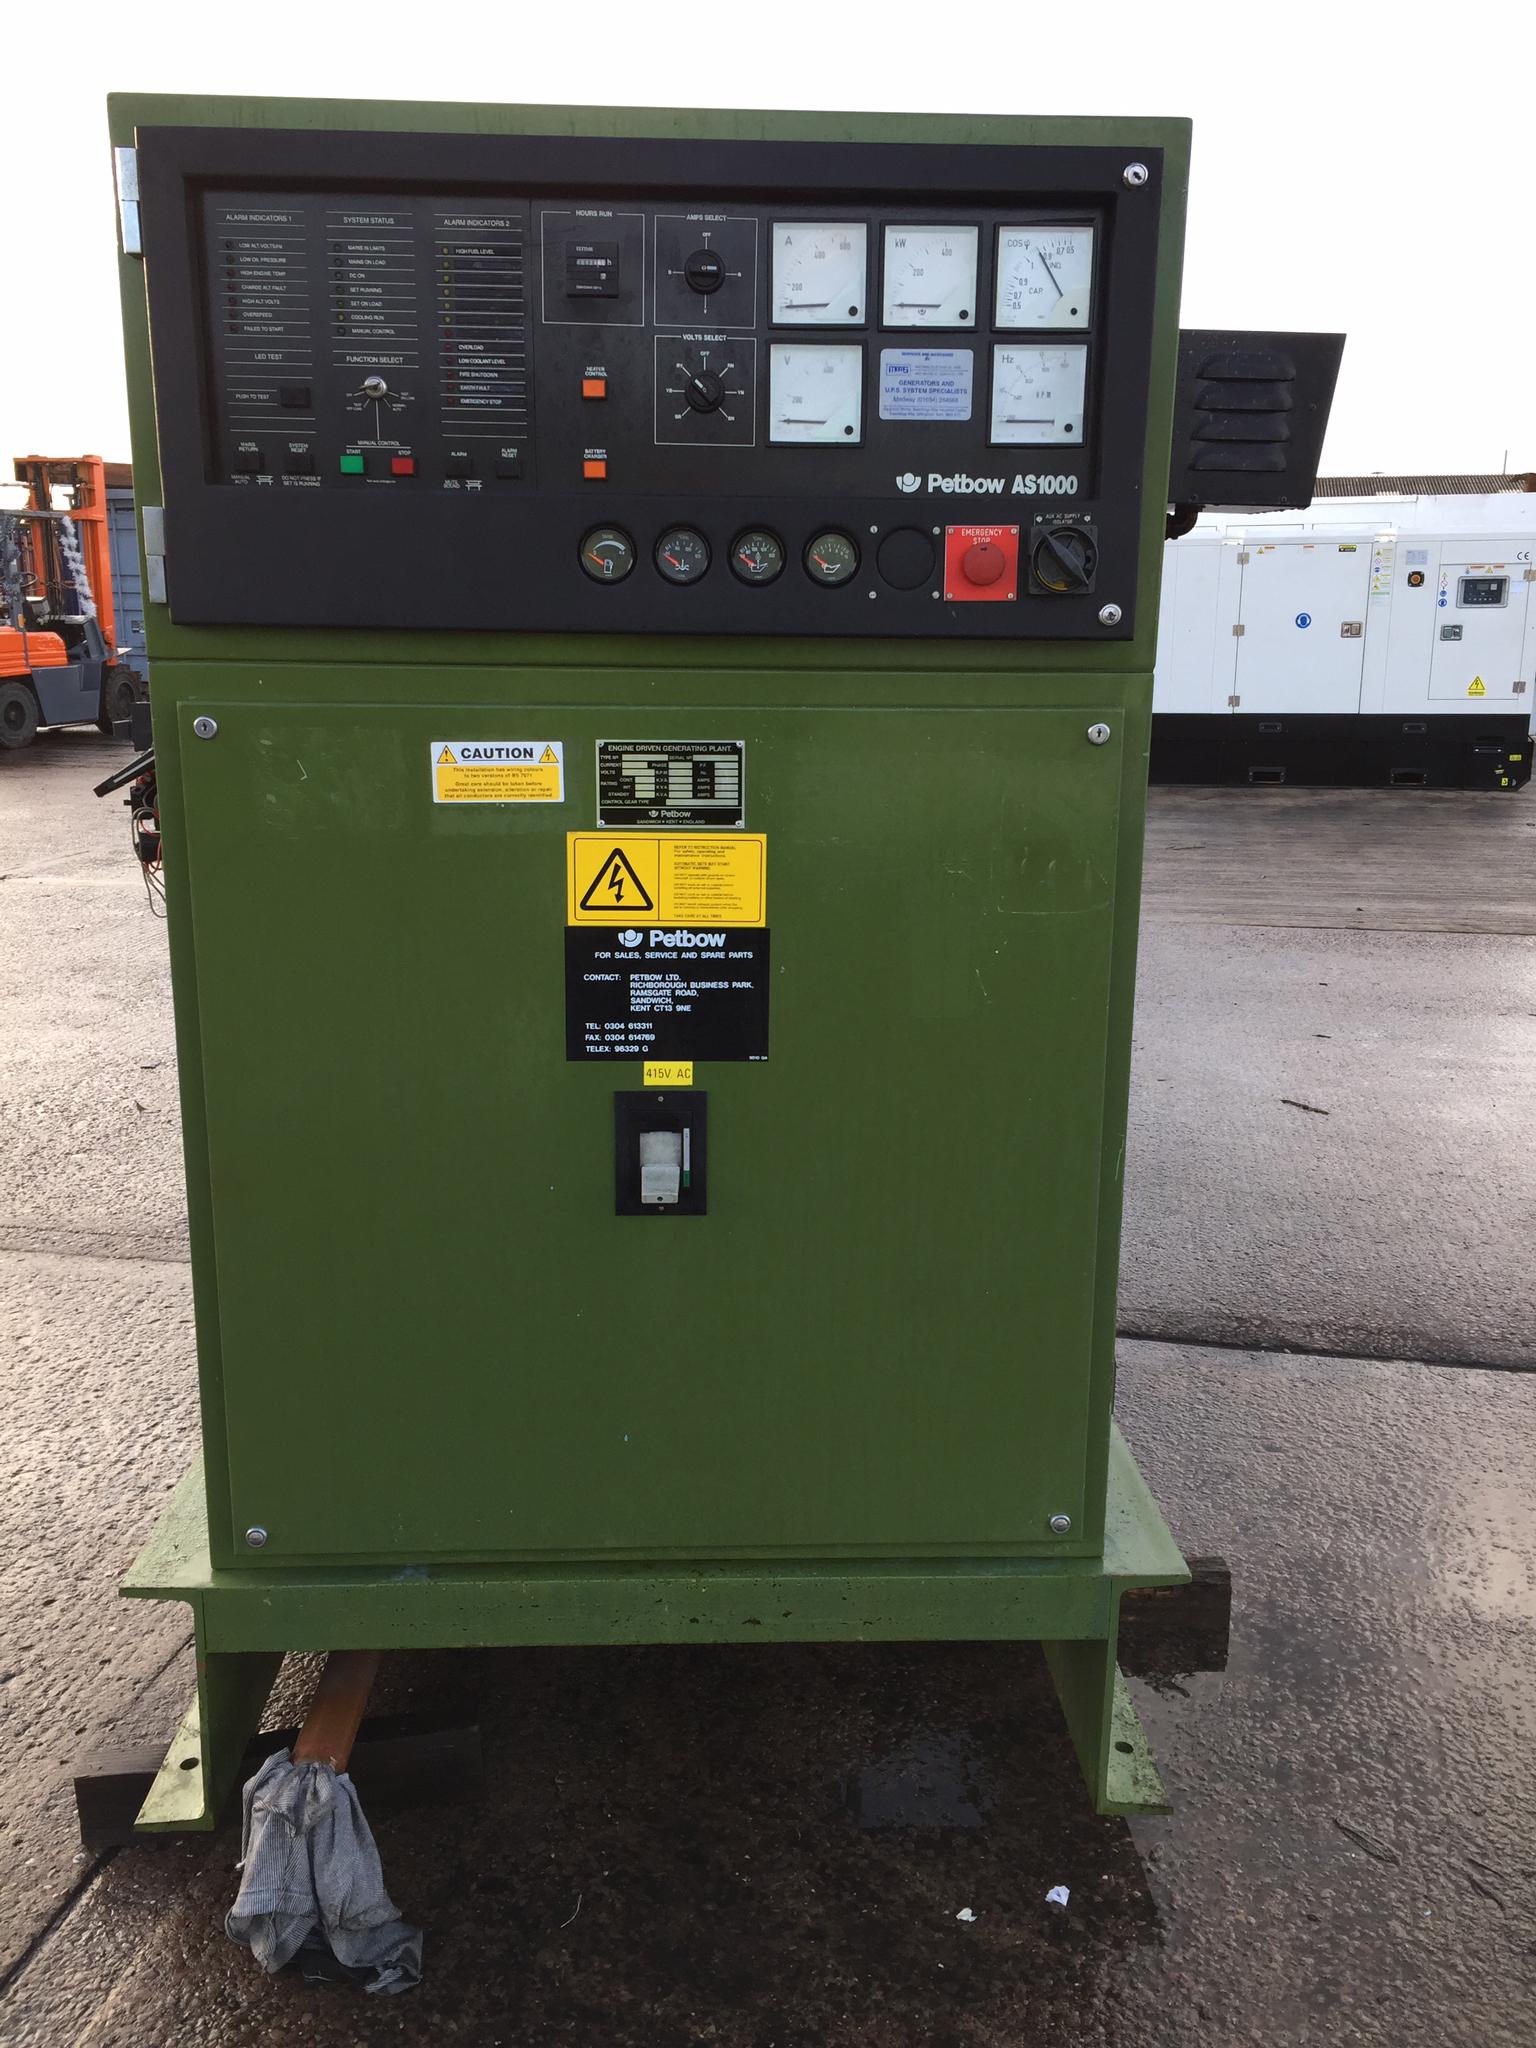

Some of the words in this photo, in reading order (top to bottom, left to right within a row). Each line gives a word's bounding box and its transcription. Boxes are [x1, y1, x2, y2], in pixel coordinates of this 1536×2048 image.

[704, 214, 727, 222] SELECT
[467, 219, 505, 227] INDICATORS
[785, 235, 792, 246] A
[895, 238, 907, 248] kW
[941, 248, 952, 256] 400
[791, 282, 803, 291] 200
[346, 355, 378, 363] FUNCTION
[784, 355, 791, 366] V
[1002, 354, 1014, 363] Hz
[927, 473, 1005, 494] Petbow
[1011, 474, 1078, 495] AS1000
[961, 528, 1002, 536] EMERGENCY
[972, 537, 991, 545] STOP
[608, 744, 634, 752] ENGINE
[460, 747, 534, 759] CAUTION
[660, 809, 692, 818] Petbow
[650, 929, 727, 948] Petbow
[614, 952, 642, 960] SALES,
[583, 973, 622, 981] CONTACT:
[629, 973, 663, 981] PETBOW
[629, 981, 688, 989] RICHBOROUGH
[629, 989, 672, 997] RAMSGATE
[675, 989, 700, 998] ROAD,
[630, 997, 674, 1005] SANDWICH,
[585, 1022, 602, 1030] TEL:
[604, 1022, 625, 1030] 0304
[628, 1022, 653, 1030] 613311
[585, 1045, 612, 1053] TELEX:
[645, 1068, 671, 1079] 415V
[676, 1068, 691, 1079] AC
